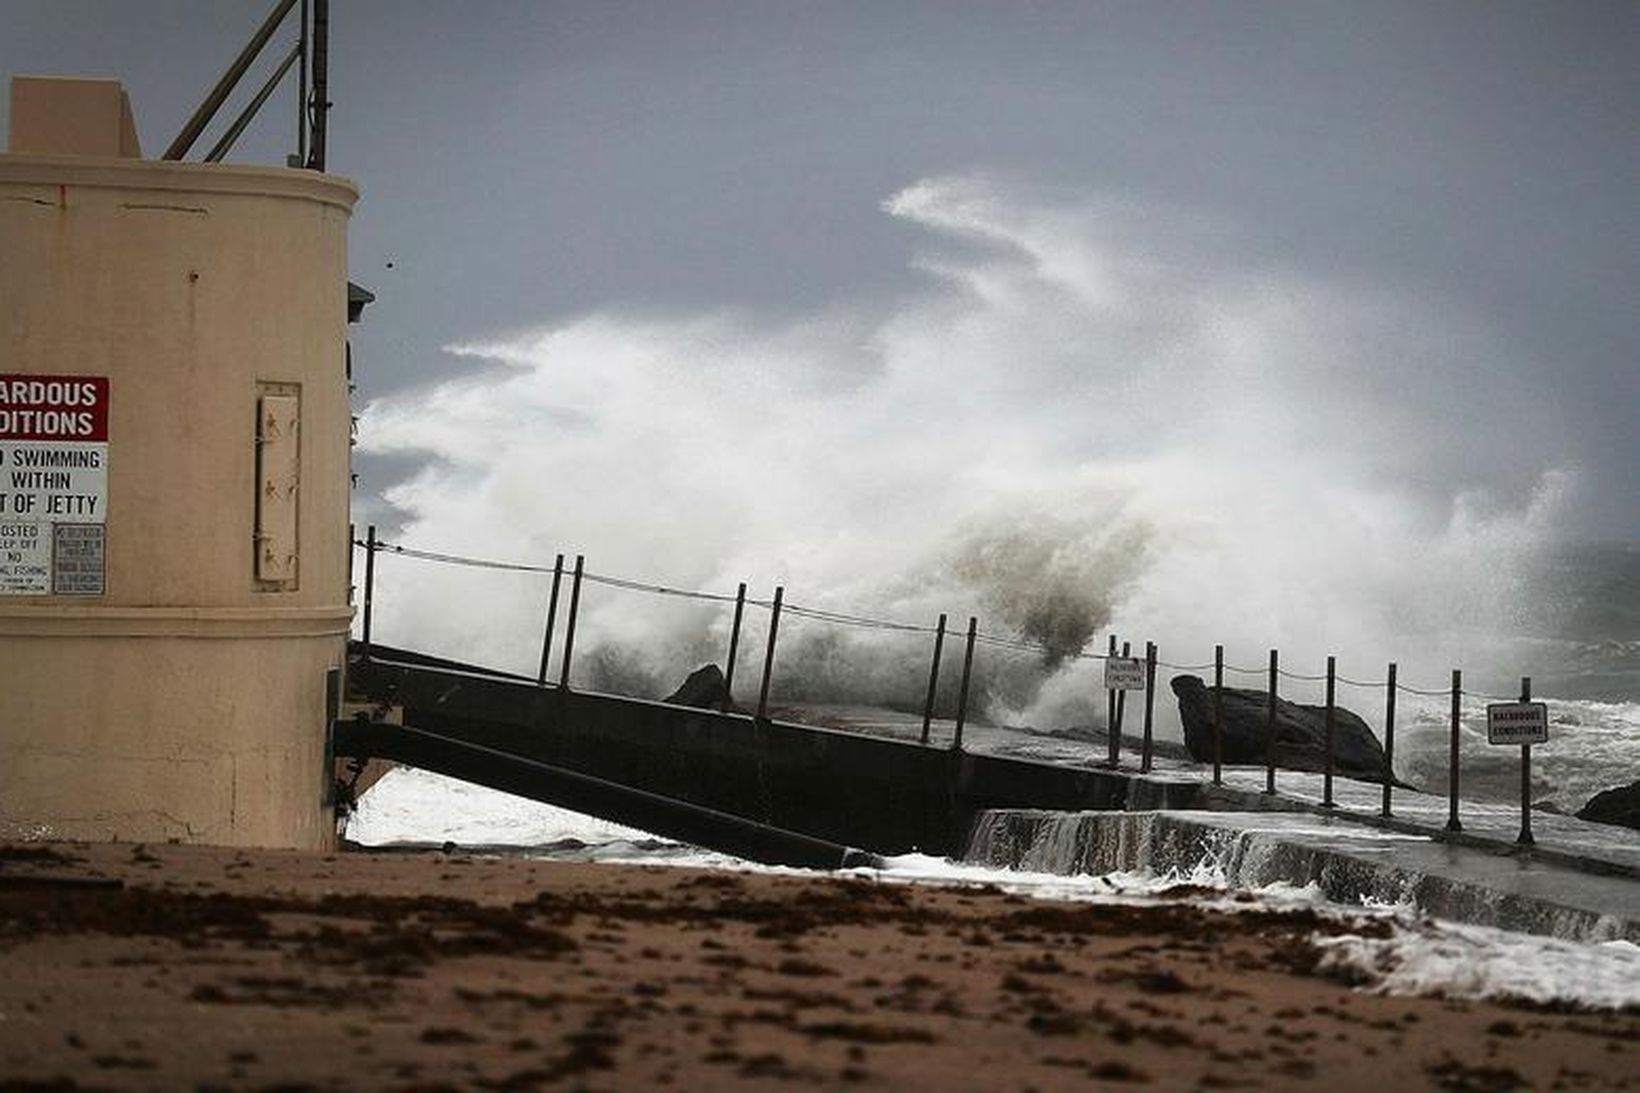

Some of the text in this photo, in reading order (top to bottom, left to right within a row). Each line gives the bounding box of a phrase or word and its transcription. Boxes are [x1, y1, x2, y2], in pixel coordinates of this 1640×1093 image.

[0, 381, 97, 406] ARDOUS
[0, 411, 94, 435] DITIONS
[13, 449, 100, 468] SWIMMING
[11, 472, 71, 490] WITHIN
[14, 494, 36, 513] OF
[46, 495, 98, 514] JETTY
